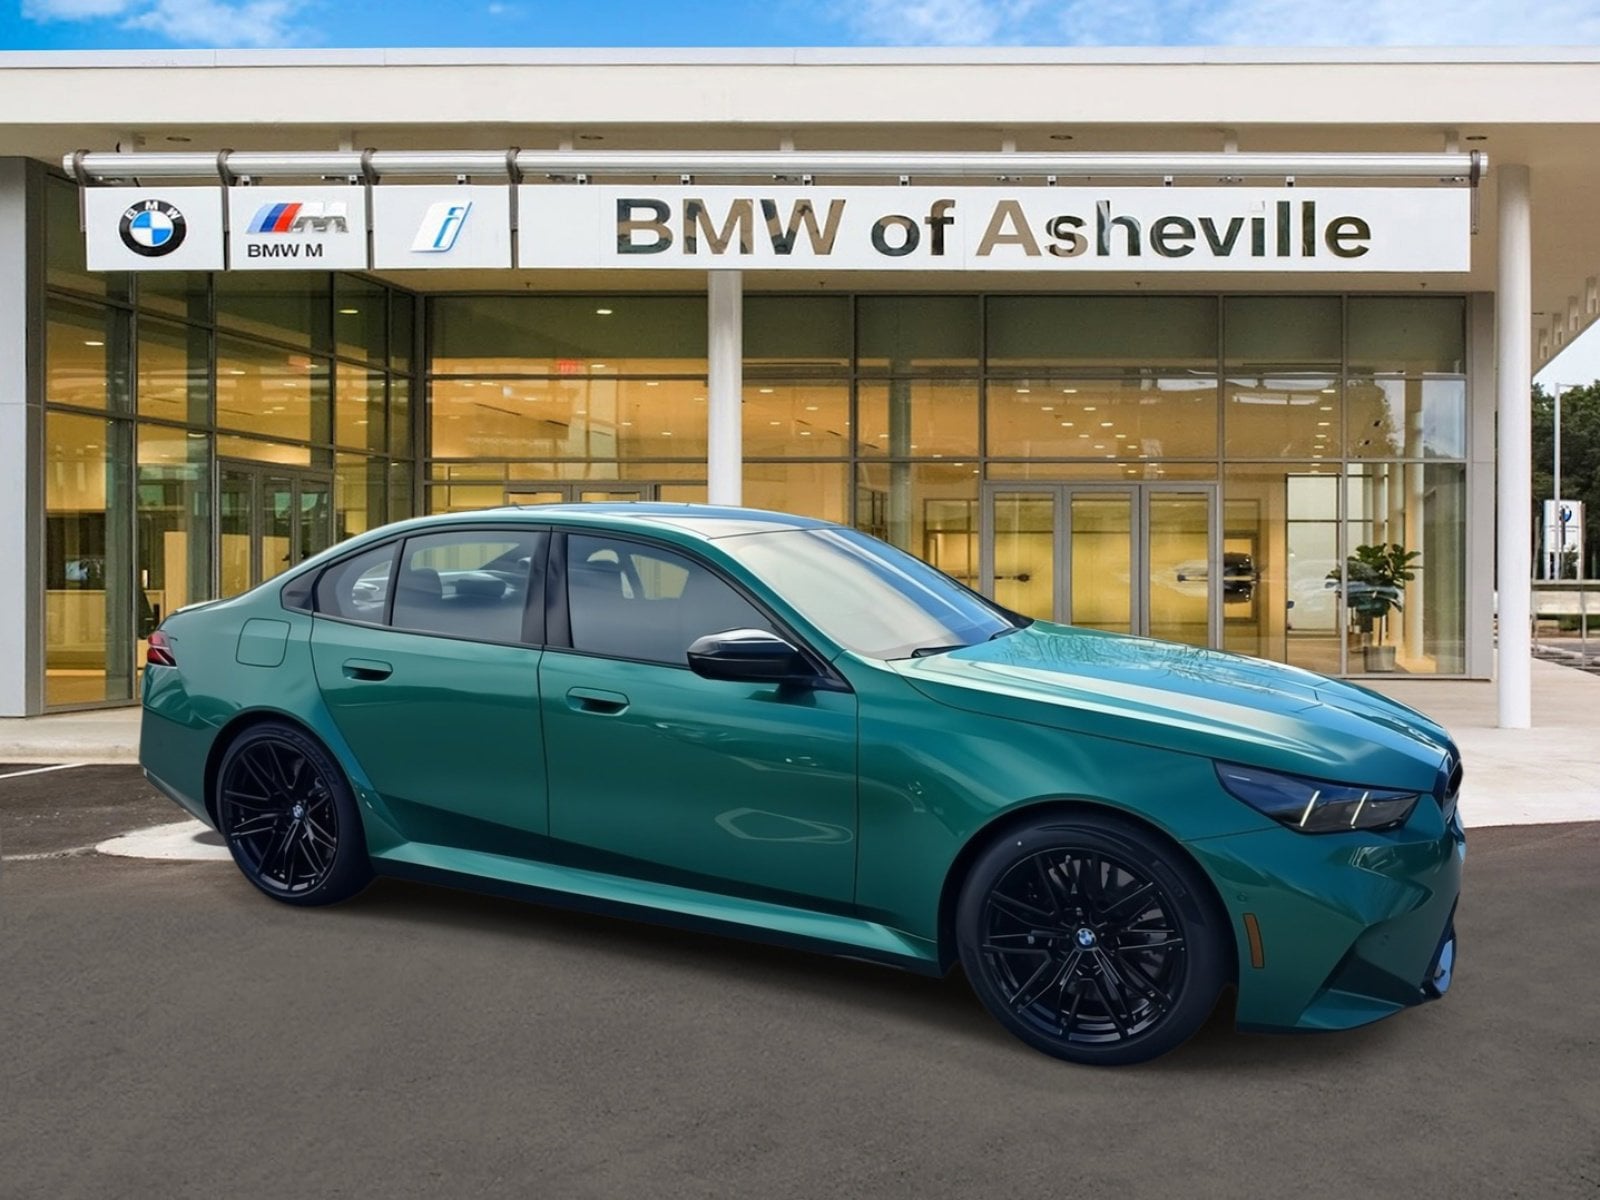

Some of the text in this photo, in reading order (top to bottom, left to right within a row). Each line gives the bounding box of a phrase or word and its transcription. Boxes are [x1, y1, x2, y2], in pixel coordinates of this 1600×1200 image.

[125, 200, 181, 220] BMW
[616, 198, 1371, 258] BMW of Asheville
[247, 243, 323, 257] BMW M
